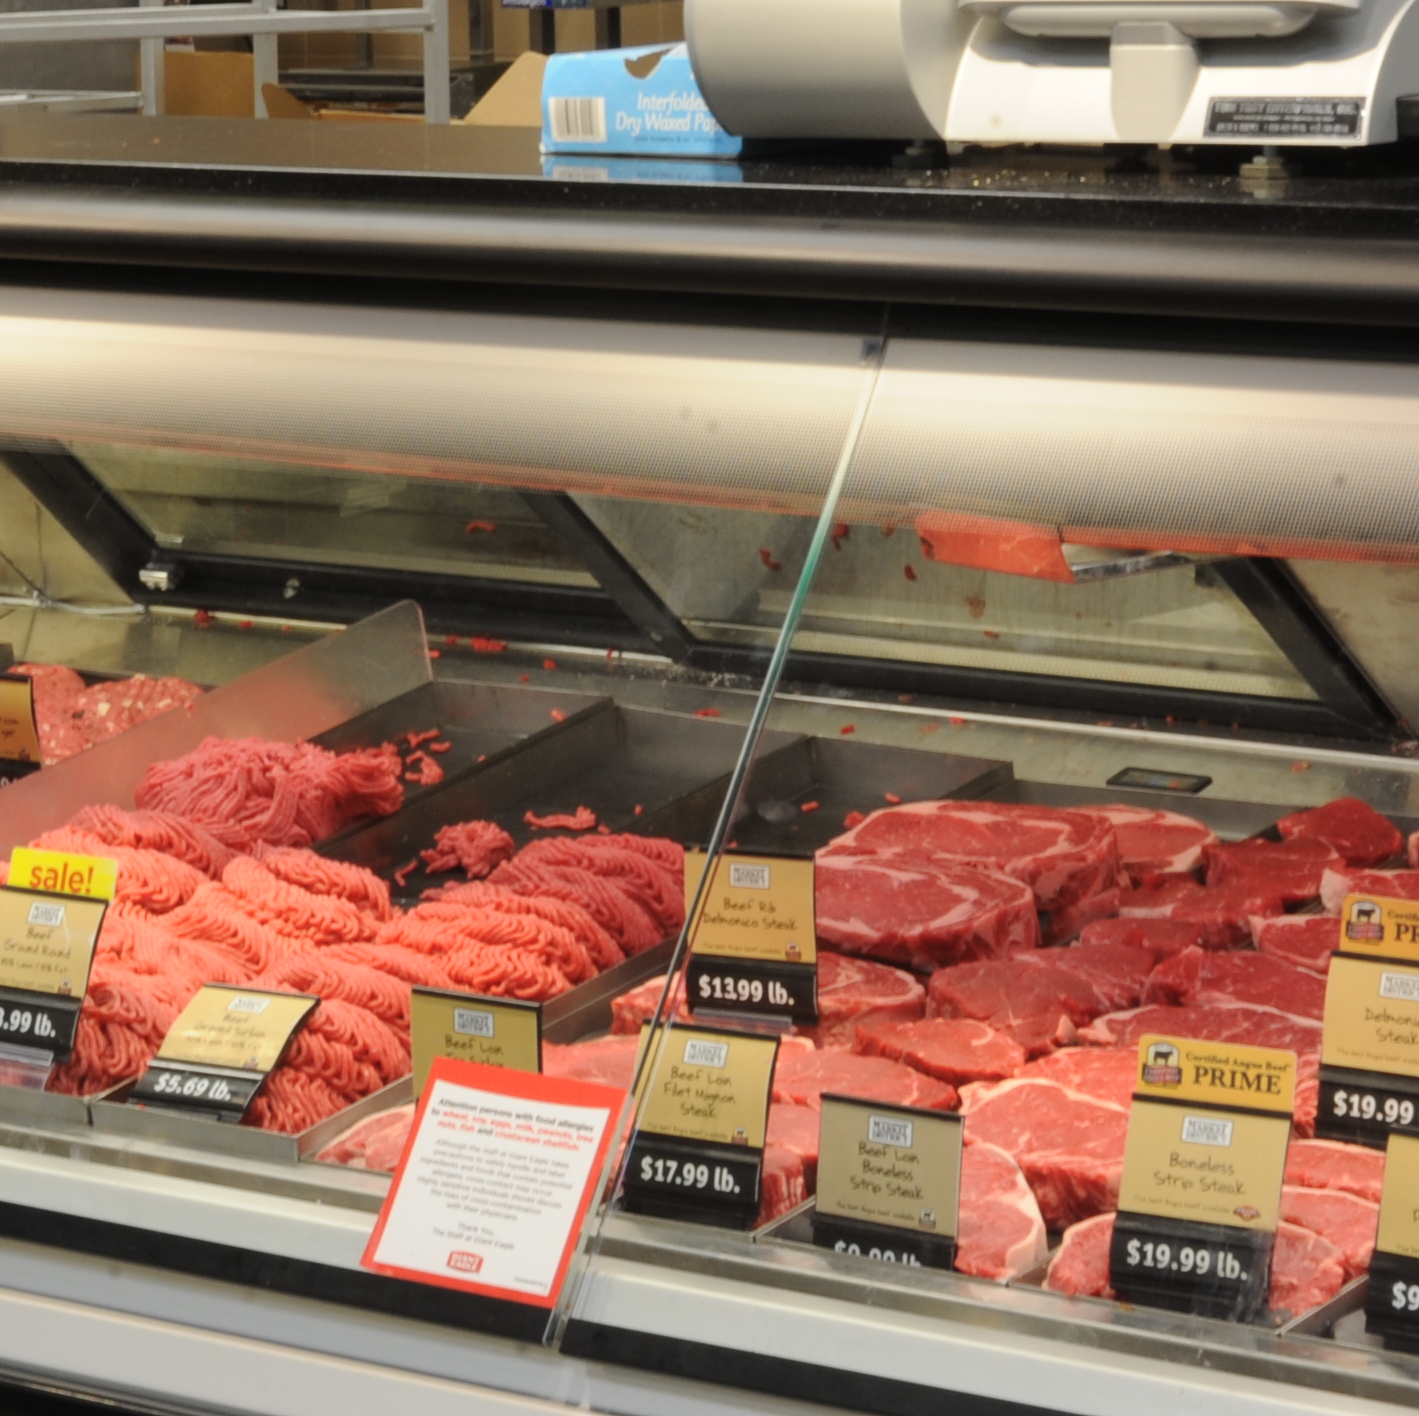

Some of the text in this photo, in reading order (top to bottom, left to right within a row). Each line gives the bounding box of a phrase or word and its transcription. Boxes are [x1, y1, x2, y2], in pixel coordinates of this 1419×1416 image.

[615, 111, 642, 136] Dry
[644, 112, 691, 132] Waxed
[30, 862, 94, 895] sale!
[723, 897, 755, 911] Beef
[703, 912, 798, 931] Delmonico Steak
[768, 981, 795, 1005] lb.
[34, 1013, 56, 1038] lb.
[445, 1034, 503, 1055] Beef Loin
[689, 1043, 725, 1058] MARKET
[1186, 1052, 1230, 1066] Certified
[1232, 1057, 1263, 1072] Angus
[154, 1072, 231, 1101] $5.69 lb.
[671, 1065, 733, 1087] Beef Loin
[1193, 1065, 1282, 1096] PRIME
[663, 1083, 736, 1109] Filet Mignon
[1333, 1089, 1414, 1125] $19.99
[438, 1098, 594, 1133] Attention persons with food allergies
[680, 1102, 717, 1118] Steak
[1188, 1120, 1230, 1136] MARKET
[858, 1140, 920, 1165] Beef Loin
[1169, 1152, 1236, 1177] Boneless
[641, 1154, 741, 1194] $17.99 lb.
[862, 1159, 914, 1182] Boneless
[850, 1175, 925, 1200] Strip Steak
[1153, 1171, 1247, 1196] Strip Steak
[1126, 1238, 1248, 1281] $19.99 lb.
